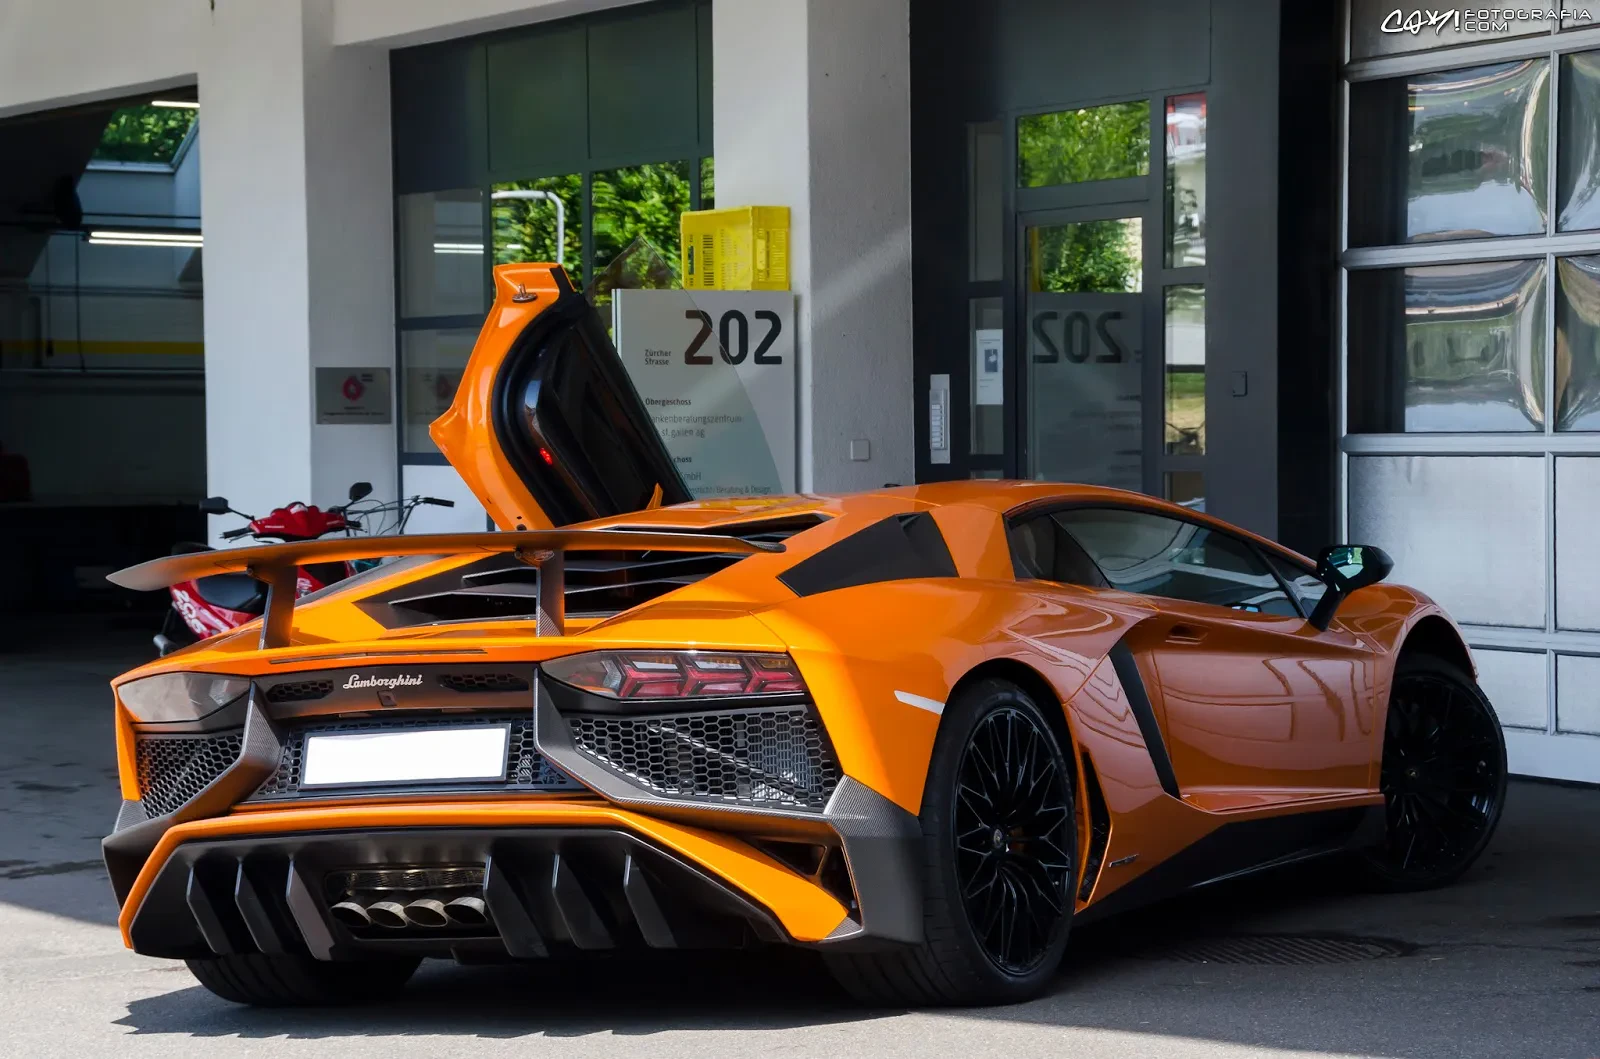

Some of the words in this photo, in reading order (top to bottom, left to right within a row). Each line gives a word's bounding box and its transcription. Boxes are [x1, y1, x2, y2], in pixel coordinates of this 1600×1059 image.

[684, 309, 782, 365] 202
[644, 348, 671, 357] Zürcher
[644, 357, 669, 365] Strasse
[645, 397, 692, 407] Obergeschoss
[651, 414, 743, 425] ankenberatungszentrum
[342, 674, 423, 689] Lamborghini
